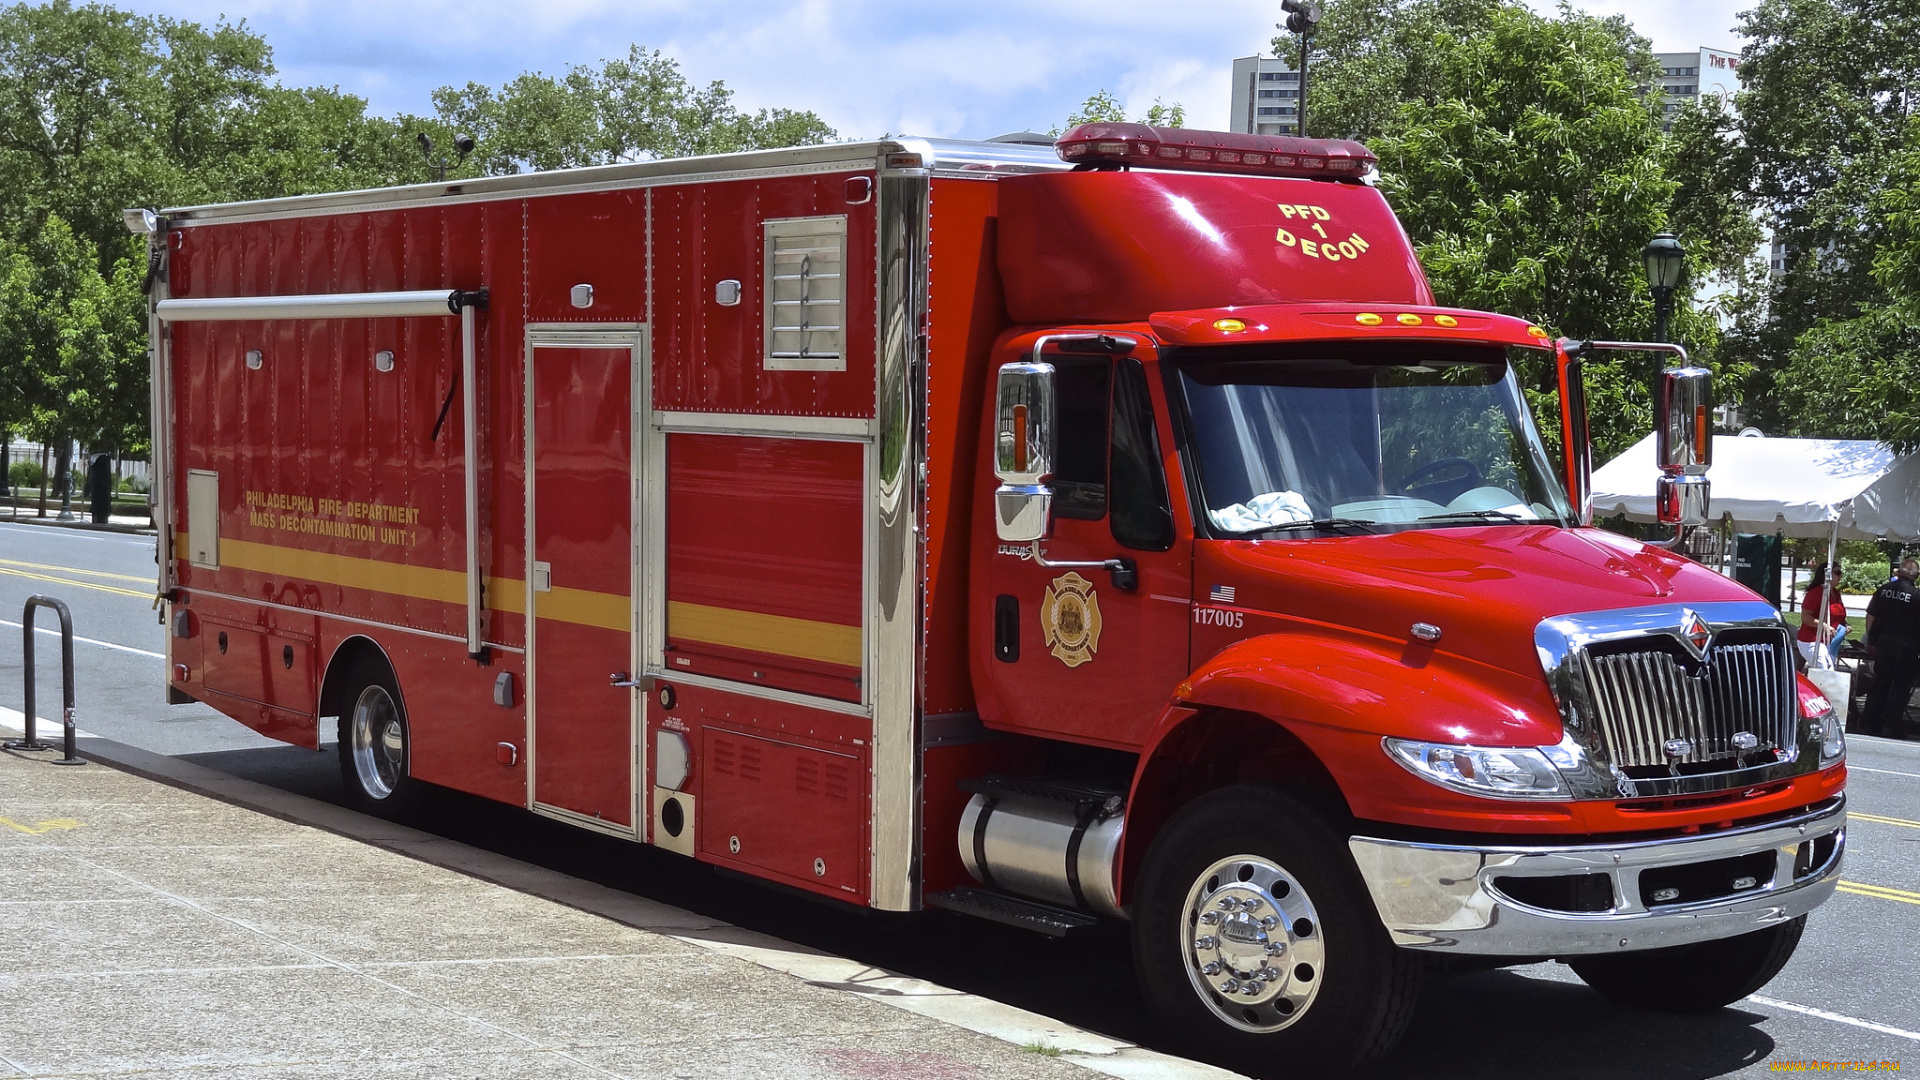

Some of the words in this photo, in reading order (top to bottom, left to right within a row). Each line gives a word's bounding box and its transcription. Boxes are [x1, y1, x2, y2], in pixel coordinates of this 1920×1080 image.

[1709, 53, 1726, 69] THE
[1277, 203, 1331, 221] PFD
[1311, 222, 1328, 239] 1
[1276, 227, 1370, 262] DECON
[246, 490, 315, 513] PHILADELPHIA
[318, 498, 342, 516] FIRE
[347, 501, 420, 525] DEPARTMENT
[250, 511, 276, 529] MASS
[279, 516, 376, 542] DECONTAMINATION
[380, 528, 408, 546] UNIT
[410, 531, 416, 547] 1
[1055, 586, 1087, 604] PHILADELPHIA
[1881, 589, 1912, 603] POLICE
[1193, 607, 1244, 629] 117005
[1061, 632, 1090, 652] DEPARTMENT
